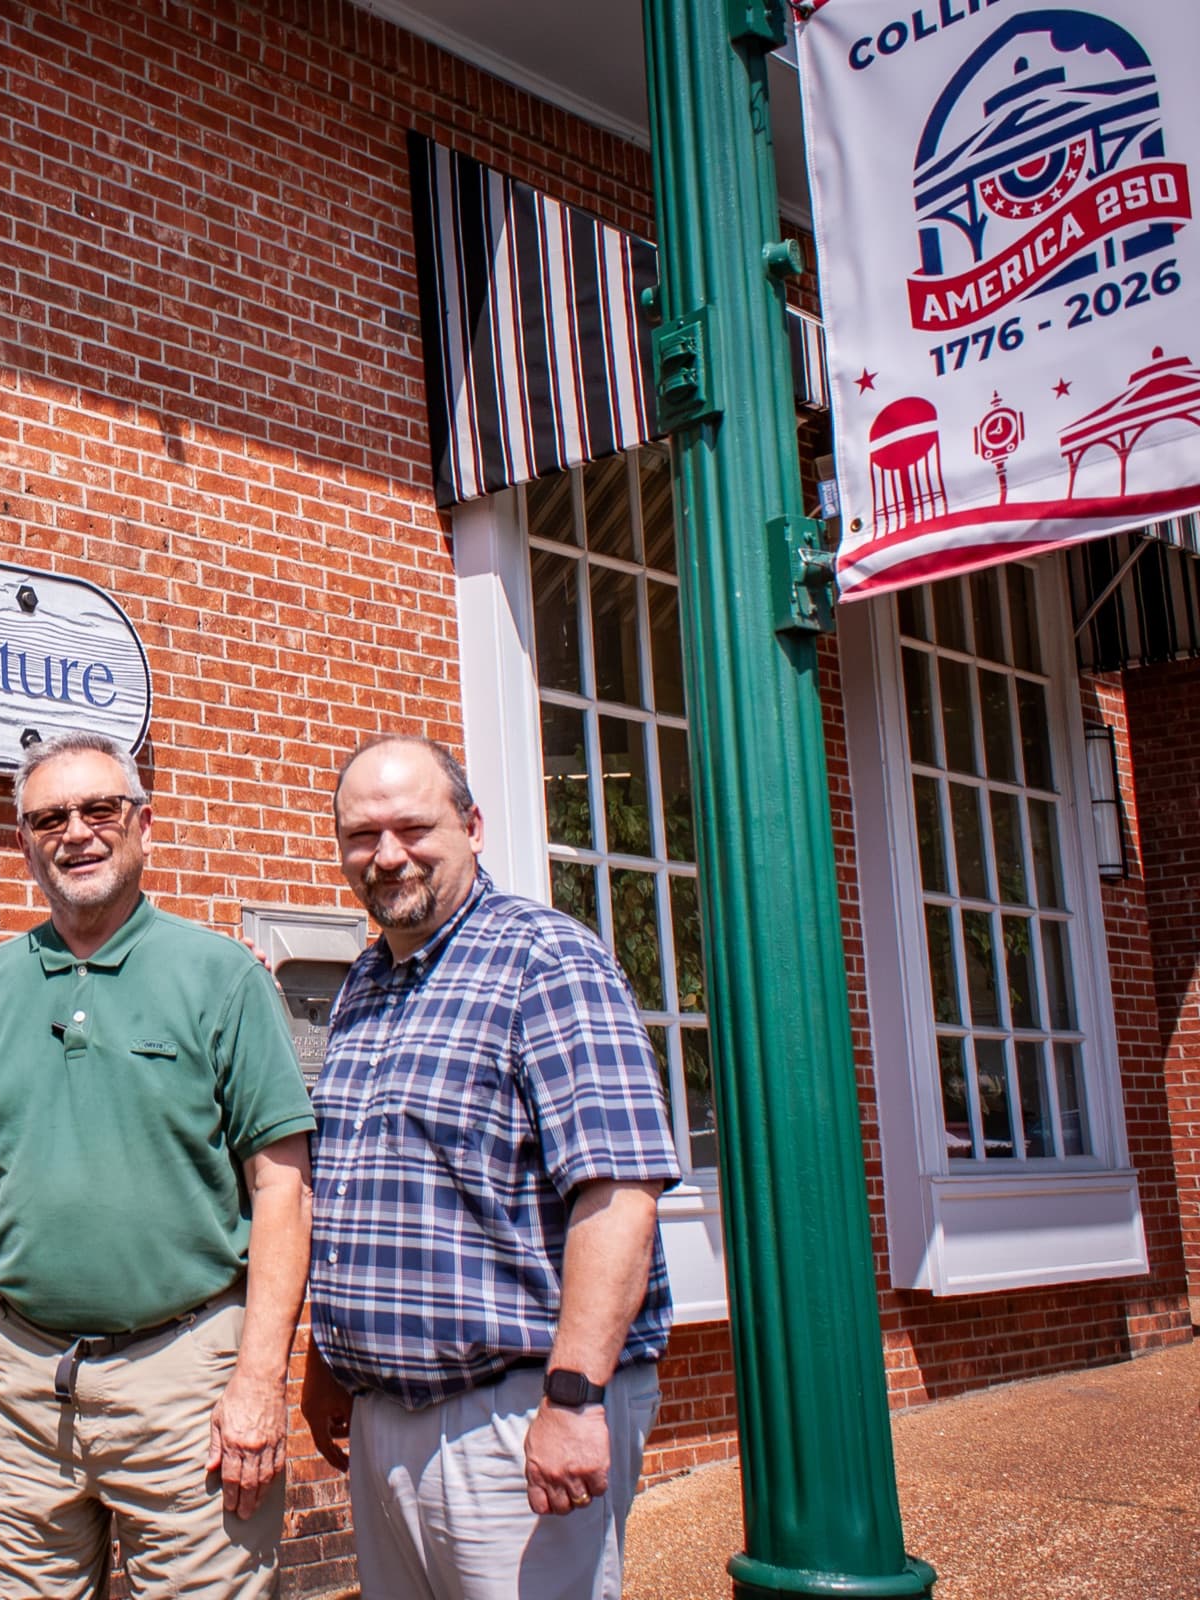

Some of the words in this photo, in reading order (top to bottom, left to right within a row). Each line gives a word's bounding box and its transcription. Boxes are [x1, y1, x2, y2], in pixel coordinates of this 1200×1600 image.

[922, 212, 1085, 322] AMERICA
[1096, 173, 1178, 224] 250
[929, 316, 1024, 377] 1776
[1064, 259, 1181, 330] 2026
